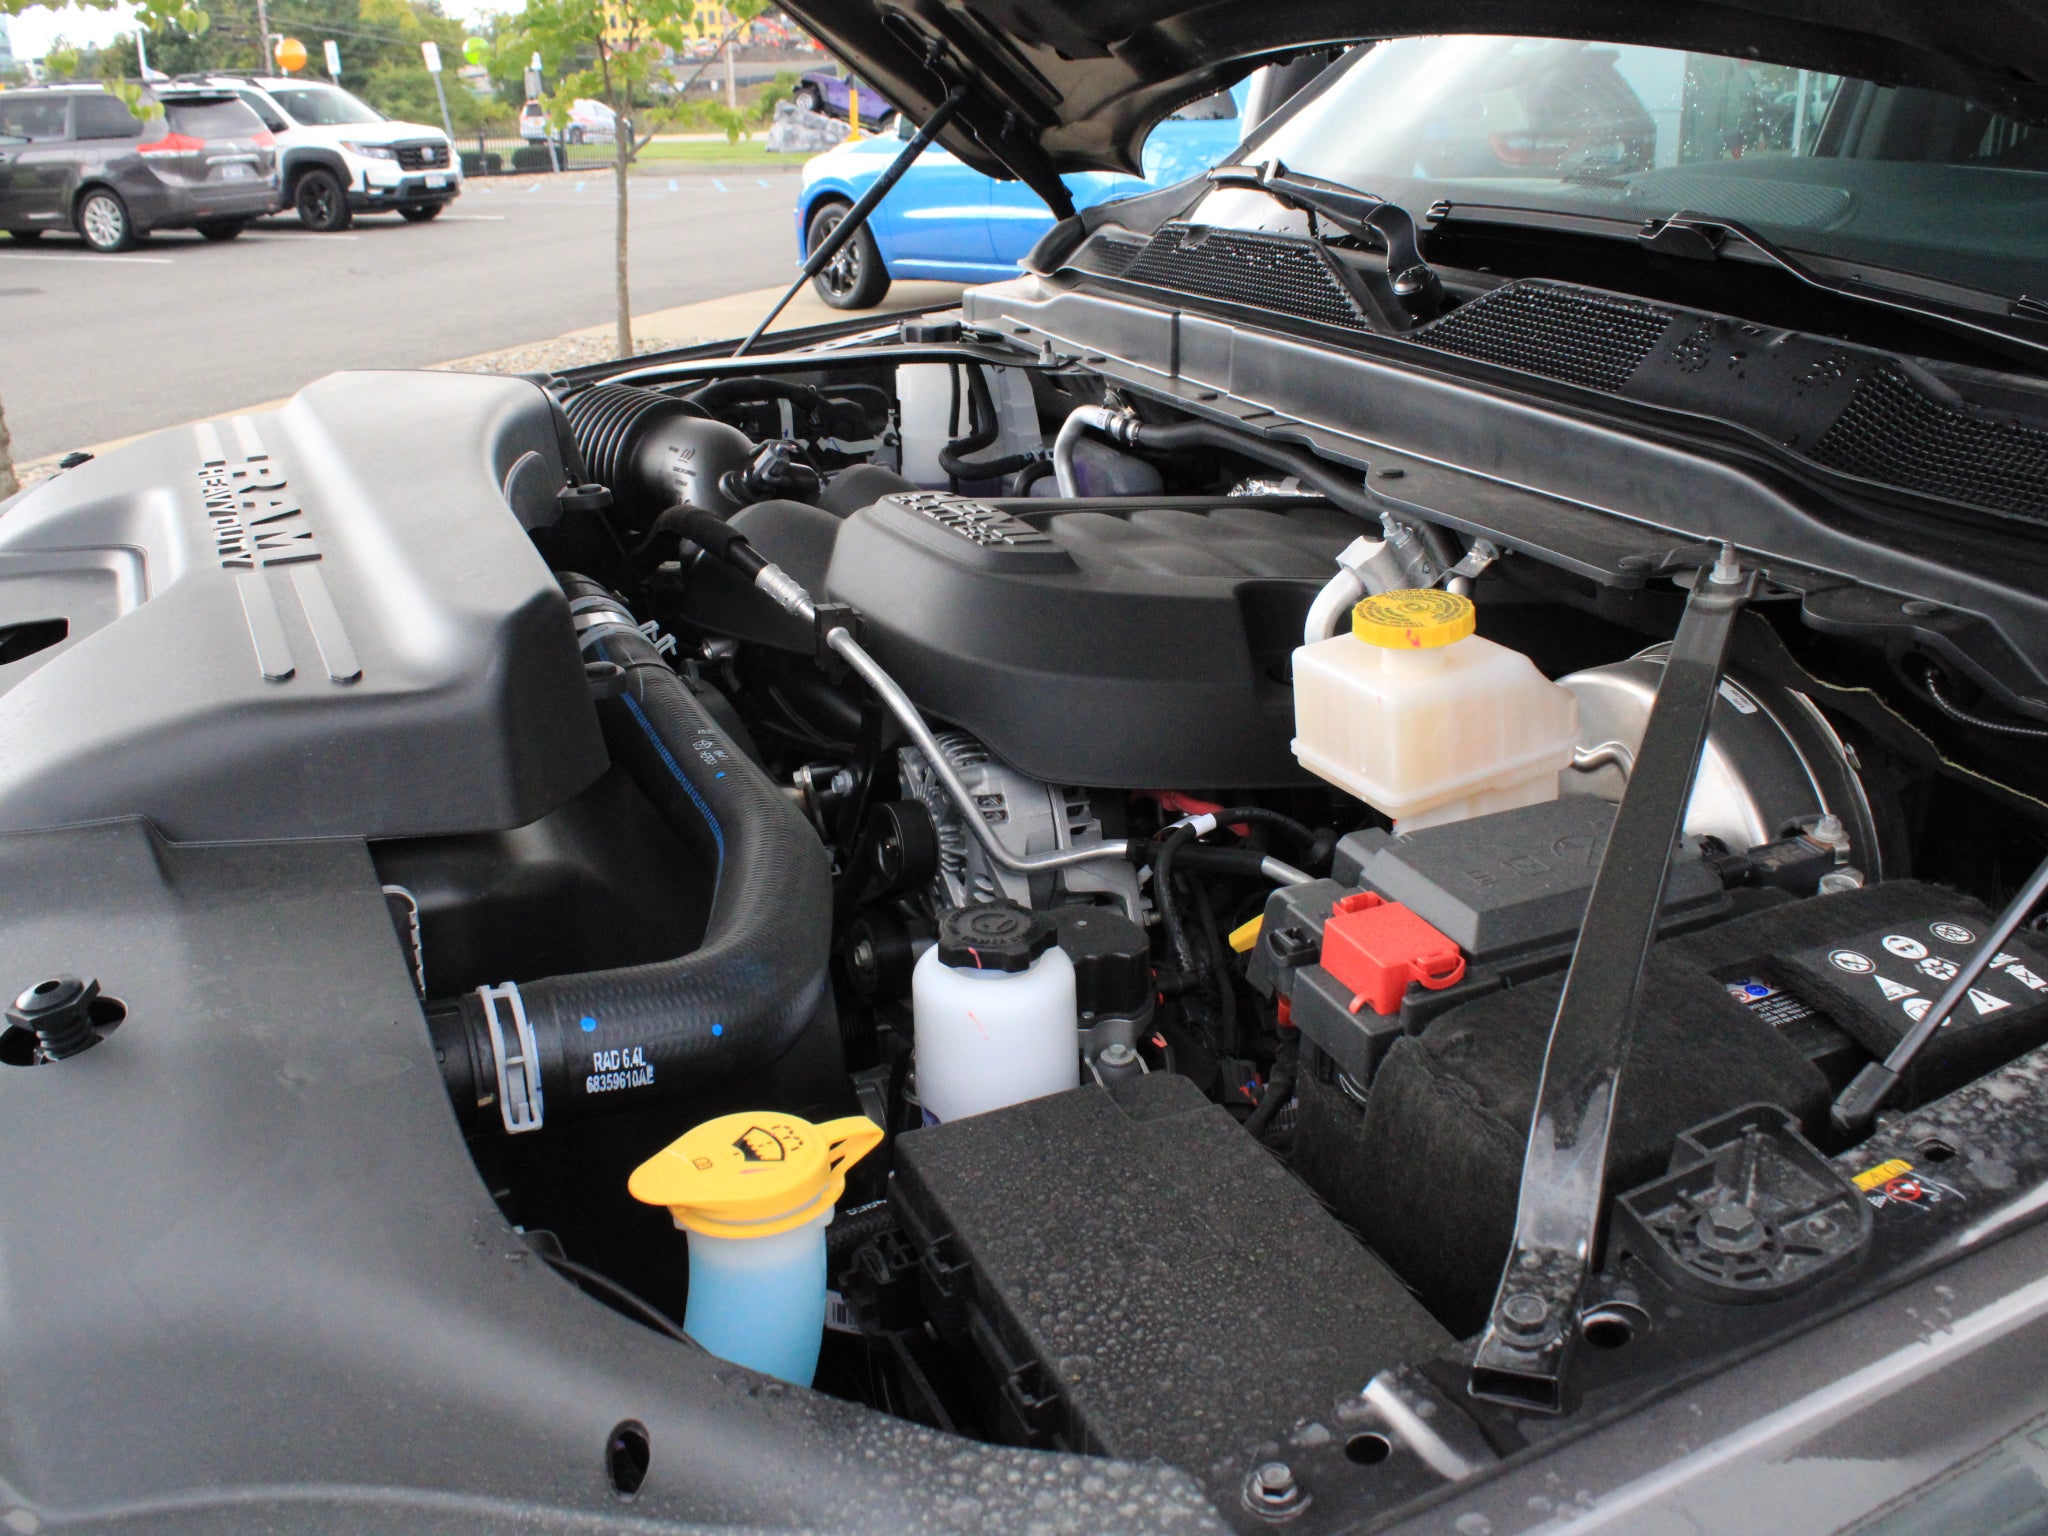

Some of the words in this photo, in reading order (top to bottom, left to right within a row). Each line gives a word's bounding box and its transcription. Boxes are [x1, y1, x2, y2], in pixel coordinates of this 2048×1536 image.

[198, 467, 238, 516] HEAVY
[230, 457, 322, 566] RAM
[911, 490, 1052, 545] HEMI
[213, 516, 255, 568] DUTY
[593, 1050, 621, 1073] RAD
[622, 1046, 647, 1069] 6.4L
